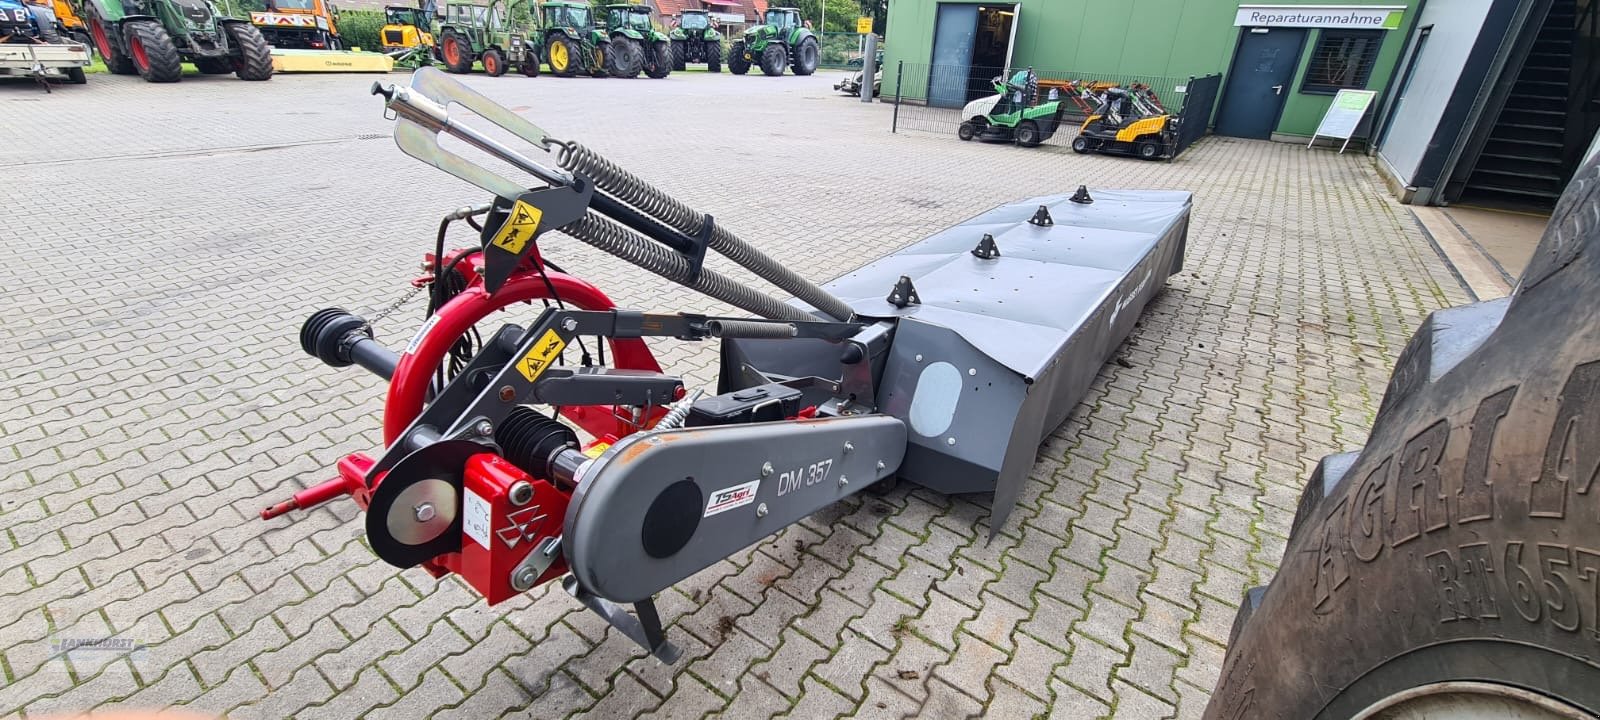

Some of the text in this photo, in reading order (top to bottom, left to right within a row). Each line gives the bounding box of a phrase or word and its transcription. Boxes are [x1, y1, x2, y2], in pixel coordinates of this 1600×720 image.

[1250, 11, 1383, 25] Reparaturannahme
[777, 458, 833, 497] DM 357
[1425, 541, 1501, 623] RT
